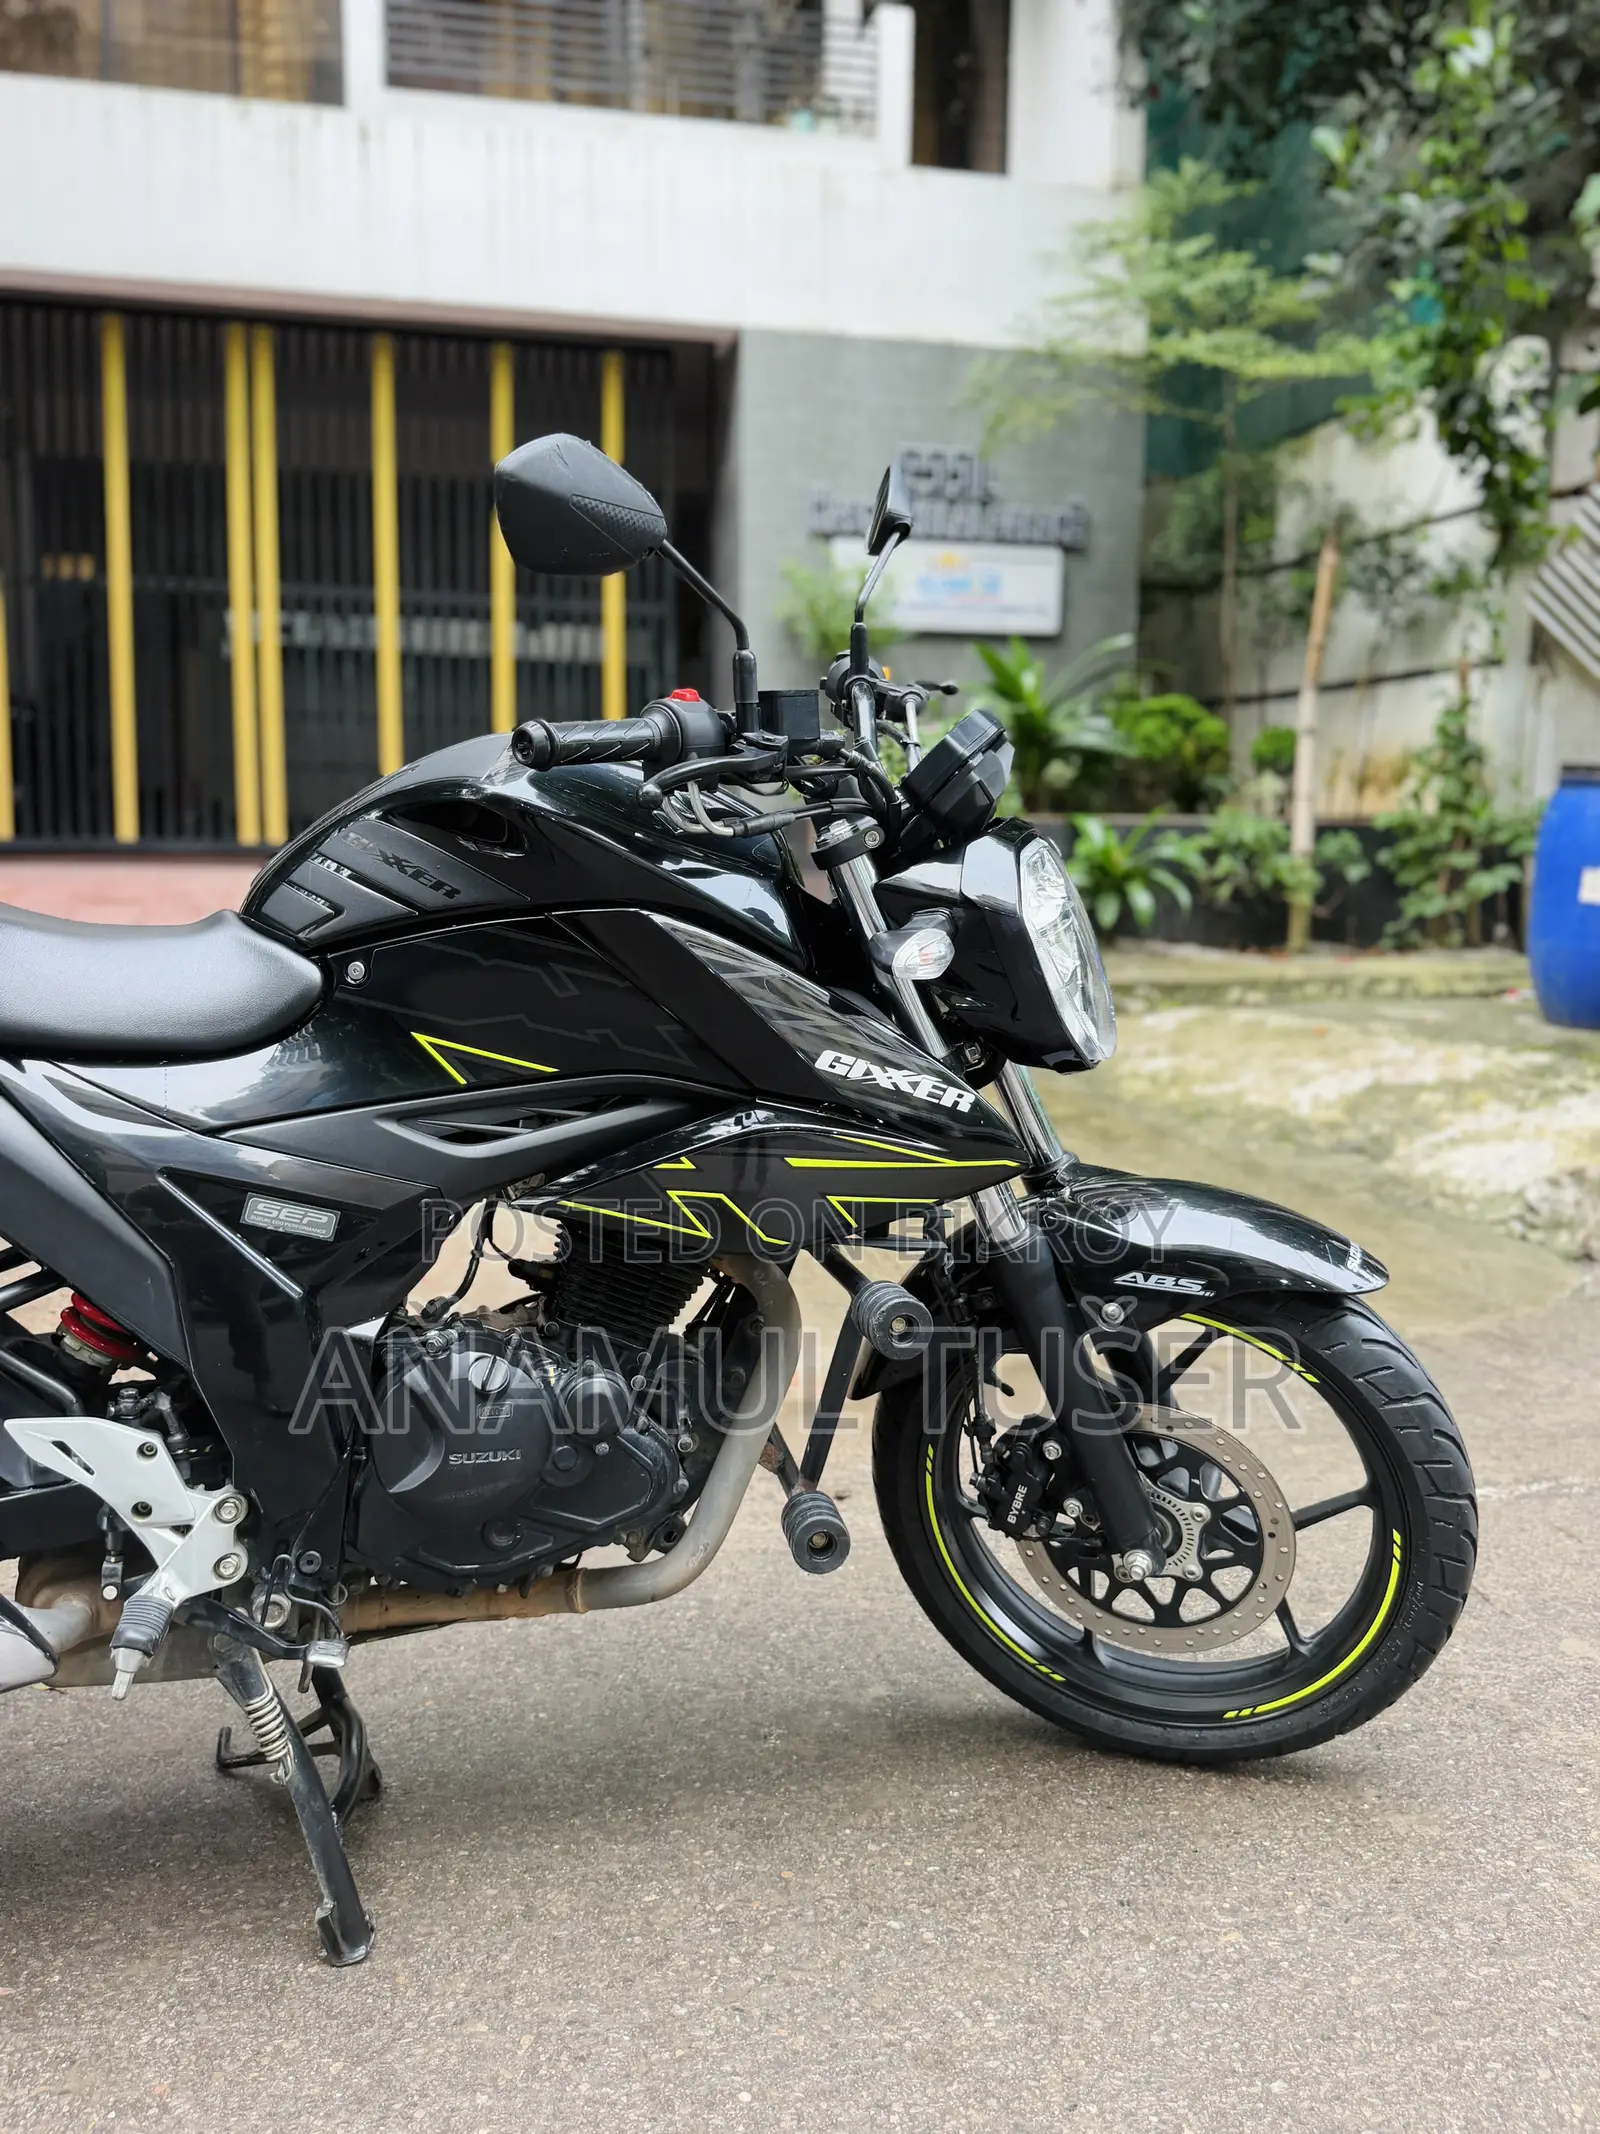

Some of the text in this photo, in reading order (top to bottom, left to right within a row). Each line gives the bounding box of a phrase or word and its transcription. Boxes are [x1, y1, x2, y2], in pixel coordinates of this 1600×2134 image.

[815, 1050, 976, 1113] GIXXER
[253, 1203, 329, 1225] SEP
[1114, 1271, 1208, 1292] ABS
[448, 1448, 522, 1465] SUZUKI
[1007, 1484, 1028, 1525] BYBRE
